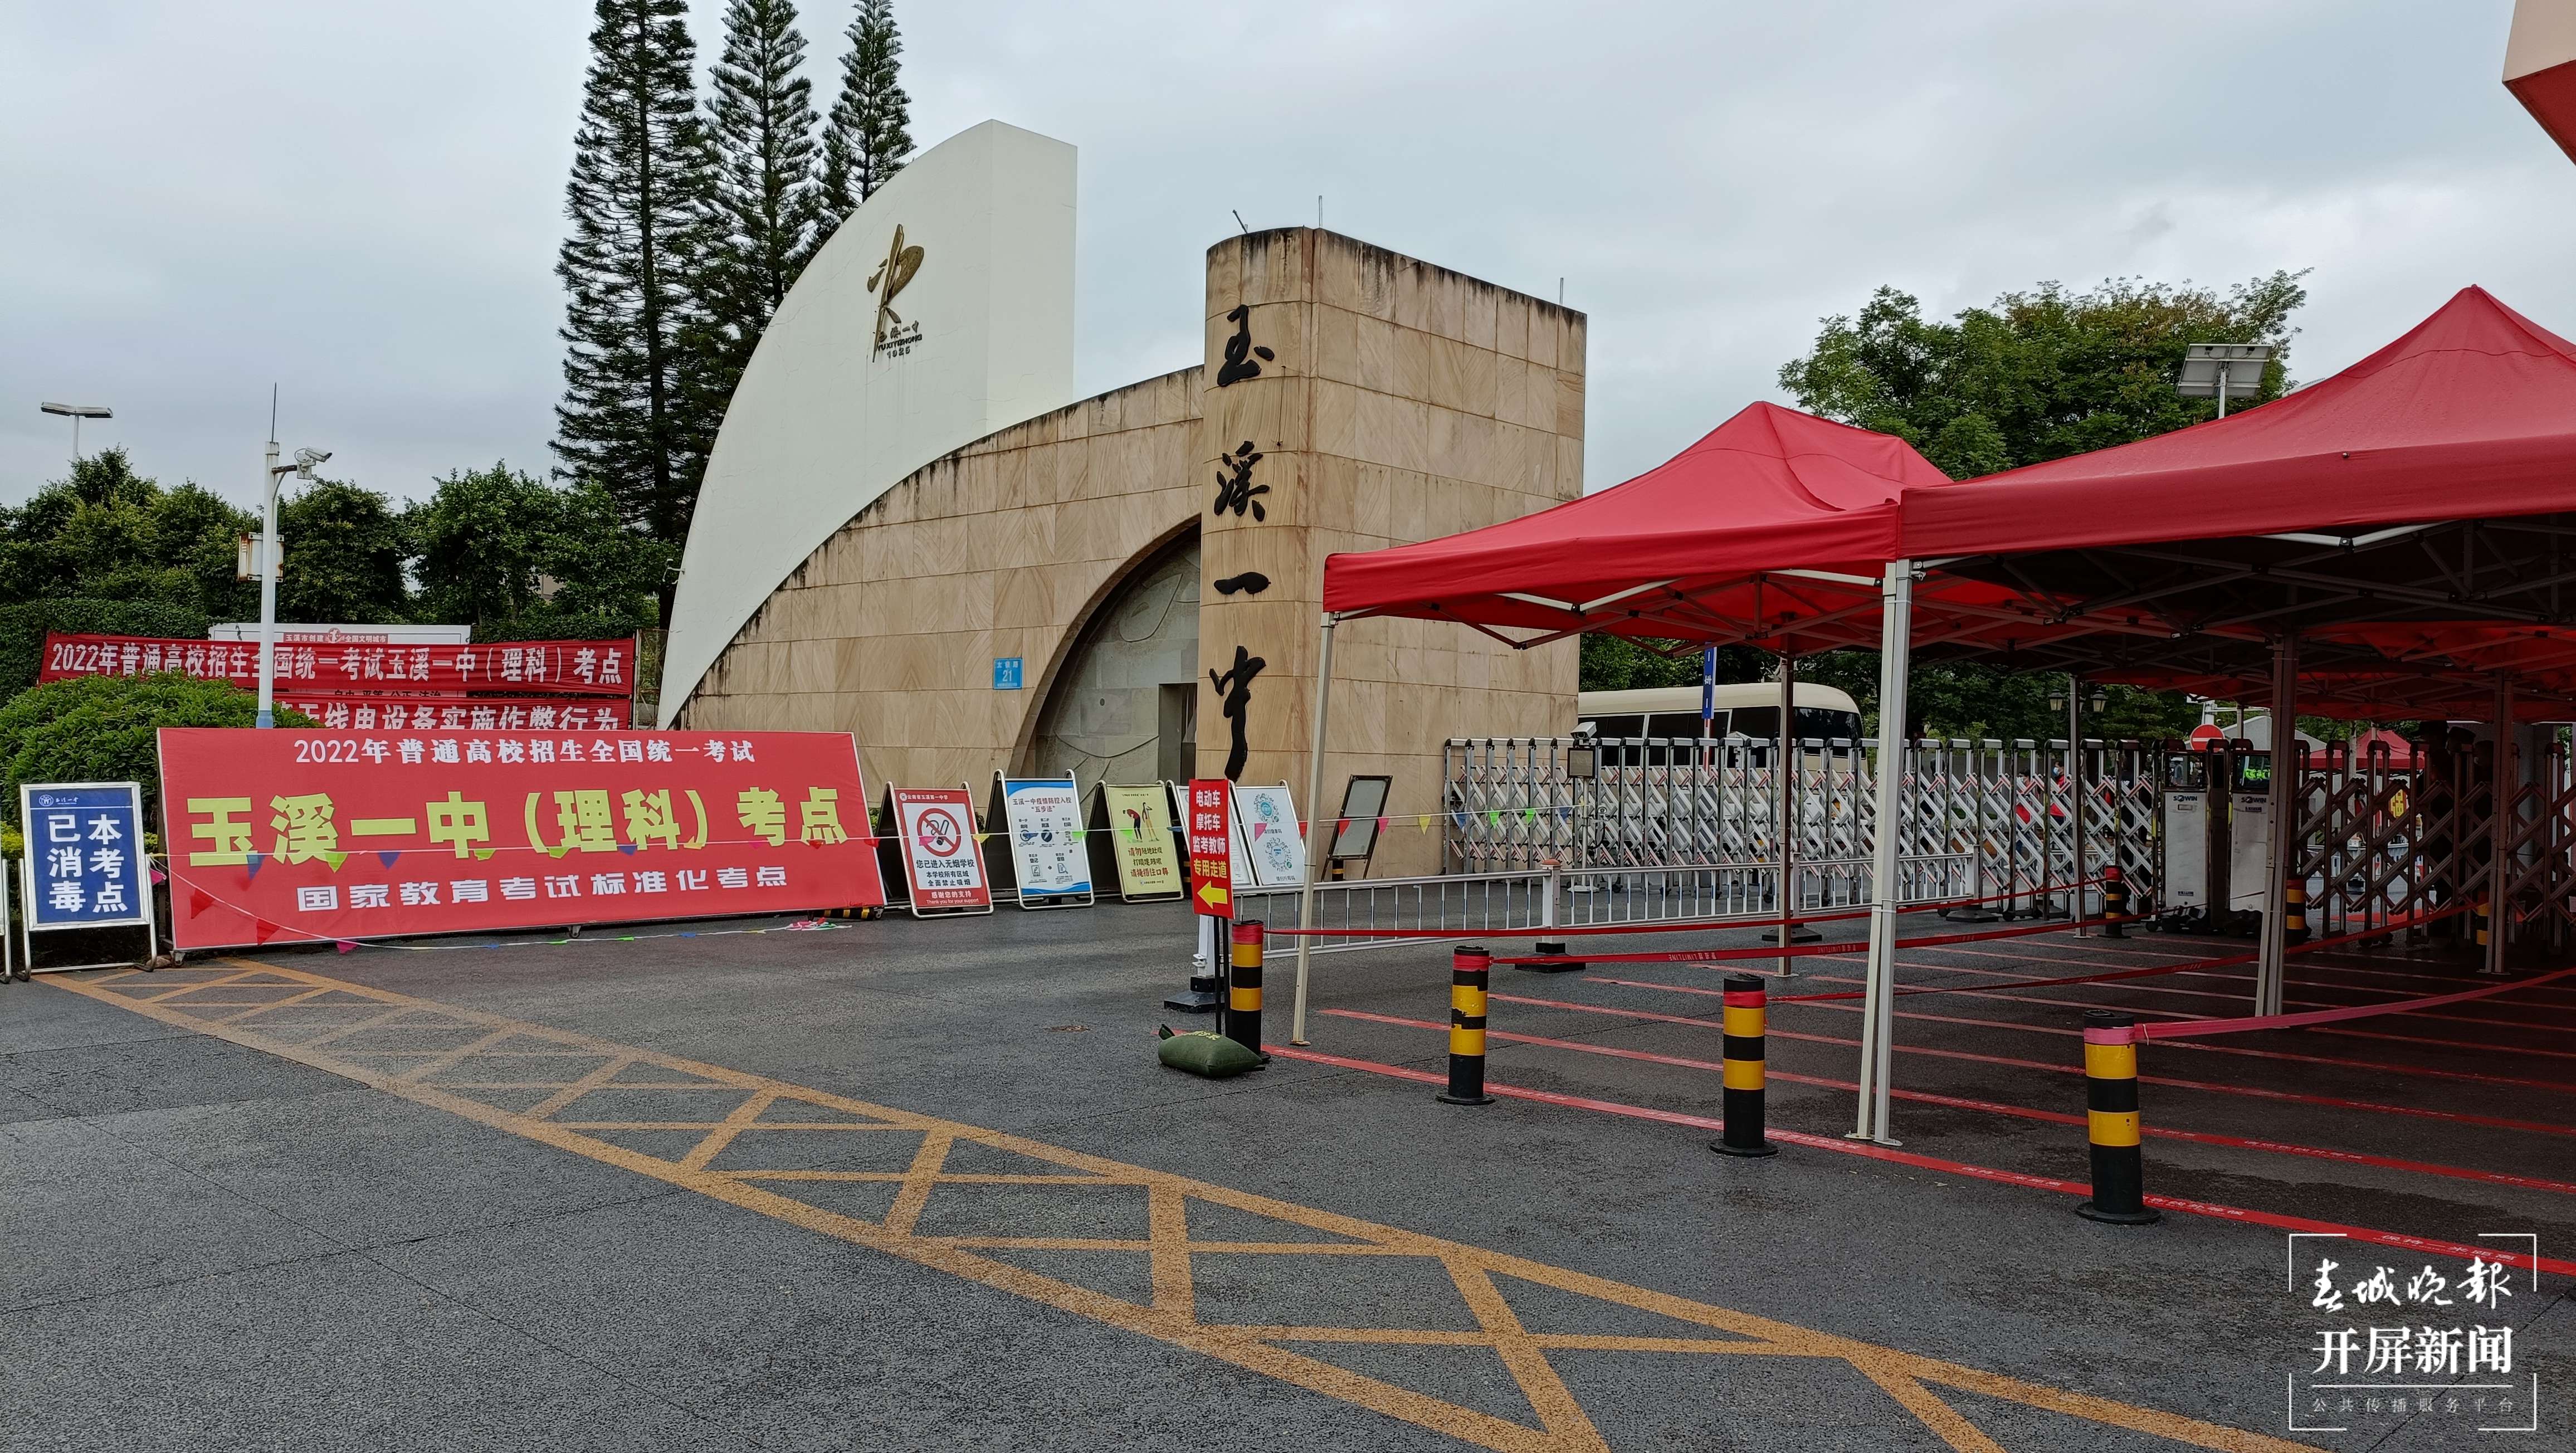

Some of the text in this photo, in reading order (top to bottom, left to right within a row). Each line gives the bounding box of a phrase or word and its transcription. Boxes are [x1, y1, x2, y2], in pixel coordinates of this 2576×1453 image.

[887, 346, 911, 359] 1925
[1209, 304, 1275, 780] 玉溪一中
[285, 634, 386, 643] 玉溪市创建 全国文明城市
[1002, 670, 1012, 682] 21
[295, 737, 755, 765] 2022年普通高校招生全国统一考试
[1013, 797, 1072, 806] 玉溪一中疫情防控入校
[1196, 789, 1221, 808] 电动车
[187, 786, 848, 867] 玉溪一中（理科）考点
[1196, 813, 1221, 831] 摩托车
[1192, 835, 1226, 855] 监考教师
[47, 815, 86, 912] 已消毒
[88, 814, 128, 913] 本考点
[916, 859, 975, 869] 您已进入无烟学校
[1193, 859, 1227, 879] 专用走道
[297, 865, 788, 913] 国家教育考试标准化考点
[928, 879, 971, 887] 全面禁止吸烟
[931, 890, 972, 899] 感谢您的支持
[1668, 953, 1697, 962] LIMITLINE
[2382, 1235, 2518, 1261] 保持一米距离
